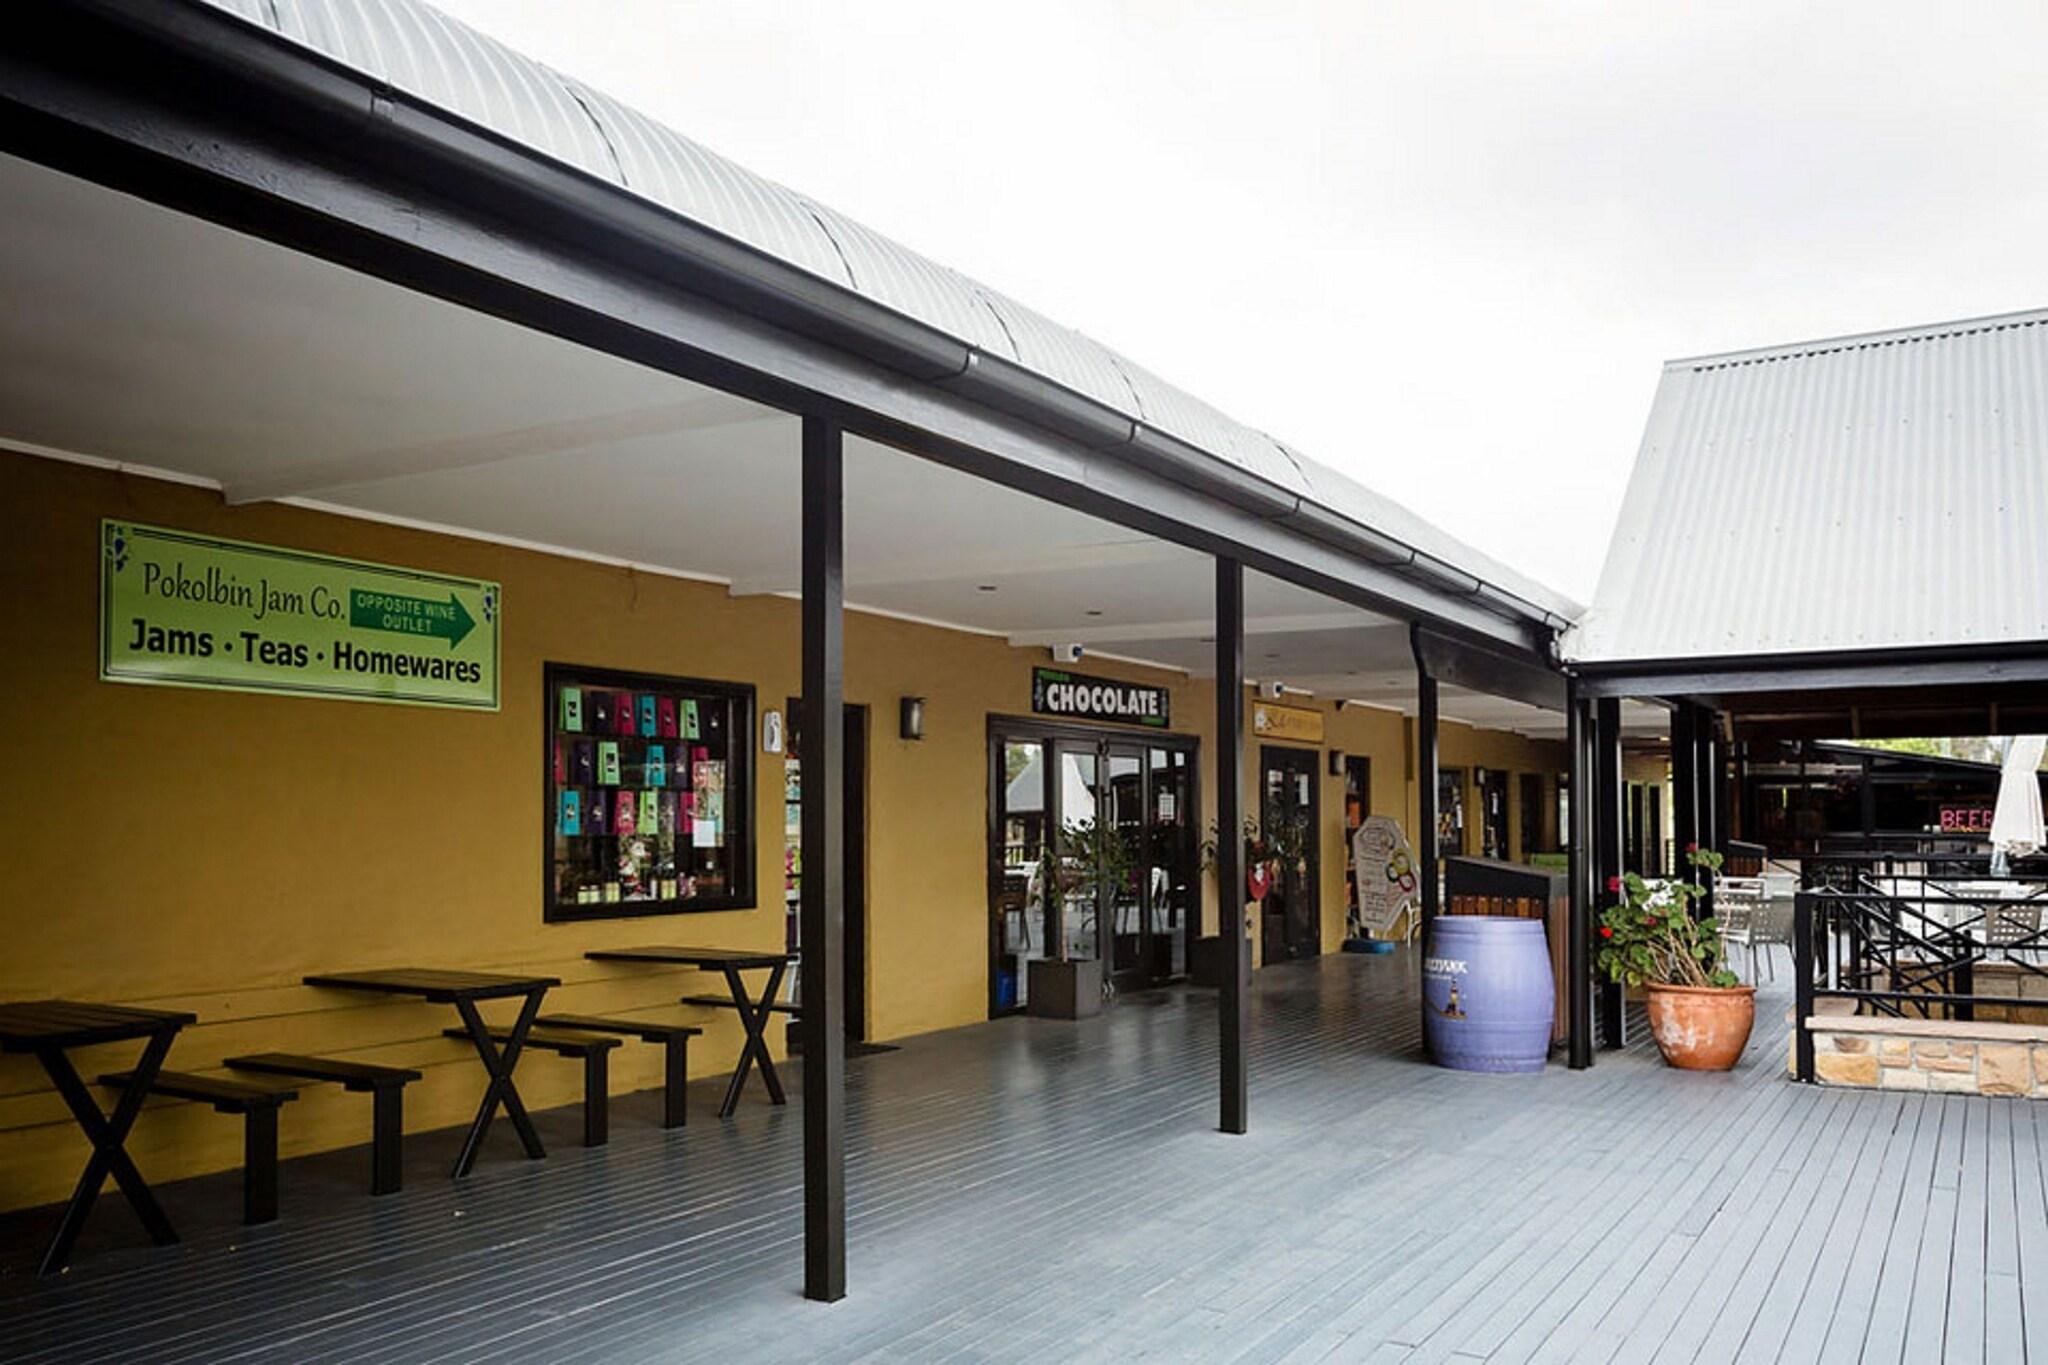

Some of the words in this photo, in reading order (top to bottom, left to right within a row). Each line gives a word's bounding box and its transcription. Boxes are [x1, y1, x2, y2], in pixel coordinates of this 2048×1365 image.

[143, 562, 253, 609] Pokolbin
[254, 579, 304, 620] Jam
[310, 586, 345, 620] Co.
[357, 593, 421, 615] OPPOSITE
[424, 602, 457, 621] WINE
[382, 613, 433, 633] OUTLET
[129, 619, 214, 657] Jams
[240, 632, 309, 668] Teas
[333, 641, 482, 683] Homewares
[1046, 682, 1159, 716] CHOCOLATE
[1941, 809, 1993, 829] BEER
